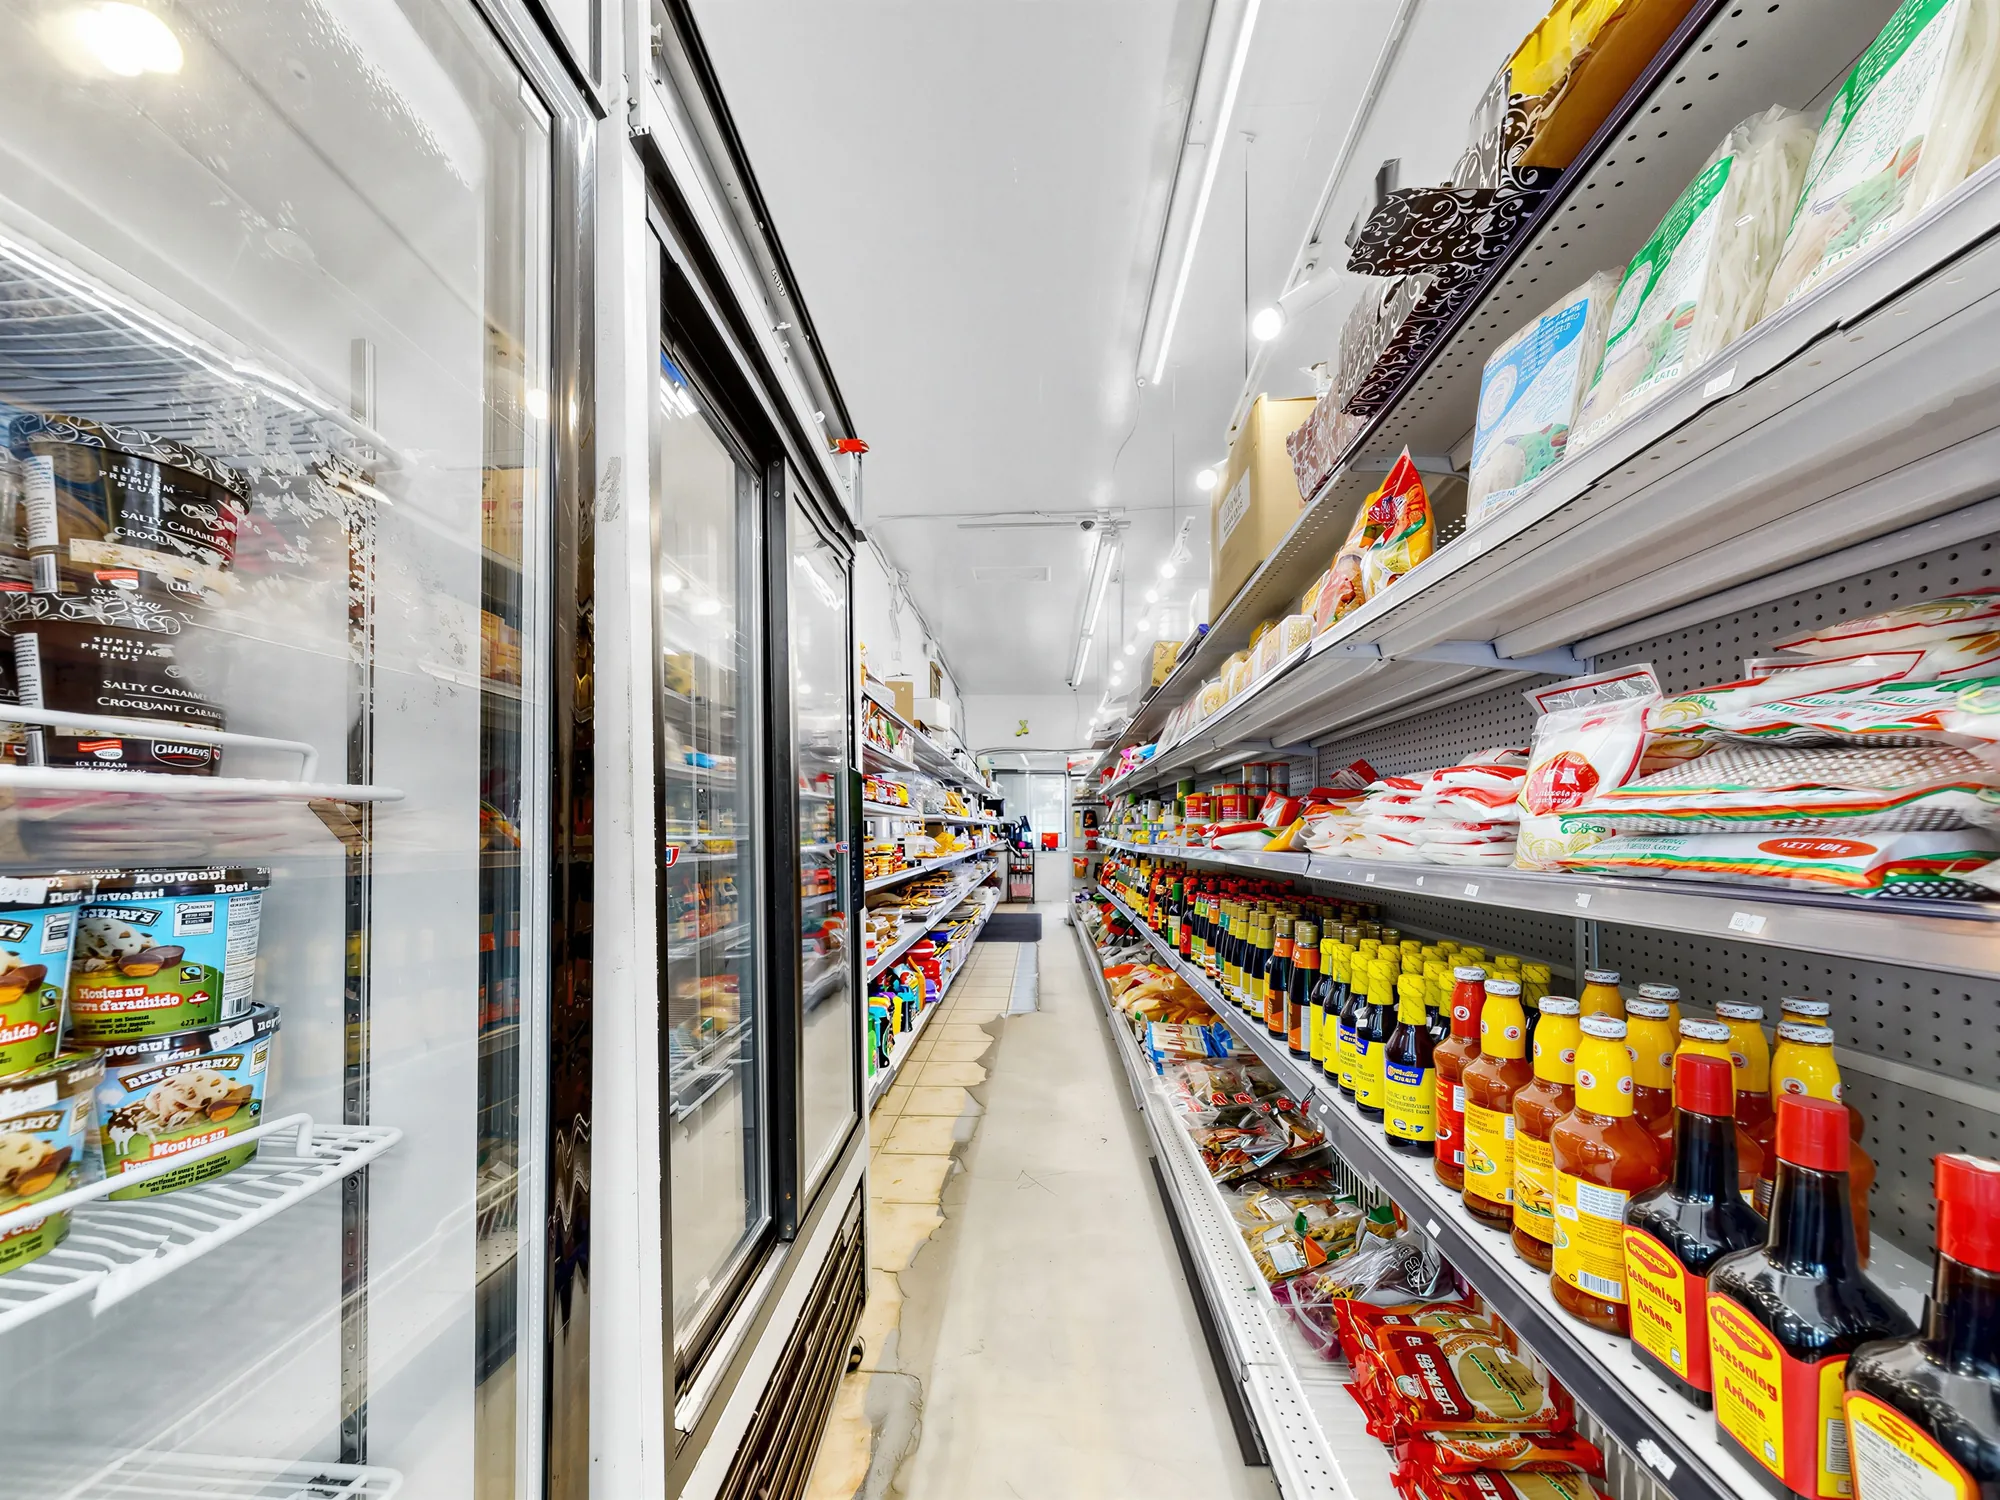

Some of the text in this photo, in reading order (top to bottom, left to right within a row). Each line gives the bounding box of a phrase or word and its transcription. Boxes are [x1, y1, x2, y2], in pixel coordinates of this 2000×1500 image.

[100, 652, 139, 662] PLUS
[102, 680, 148, 692] SALTY
[97, 697, 181, 714] CROQUANT
